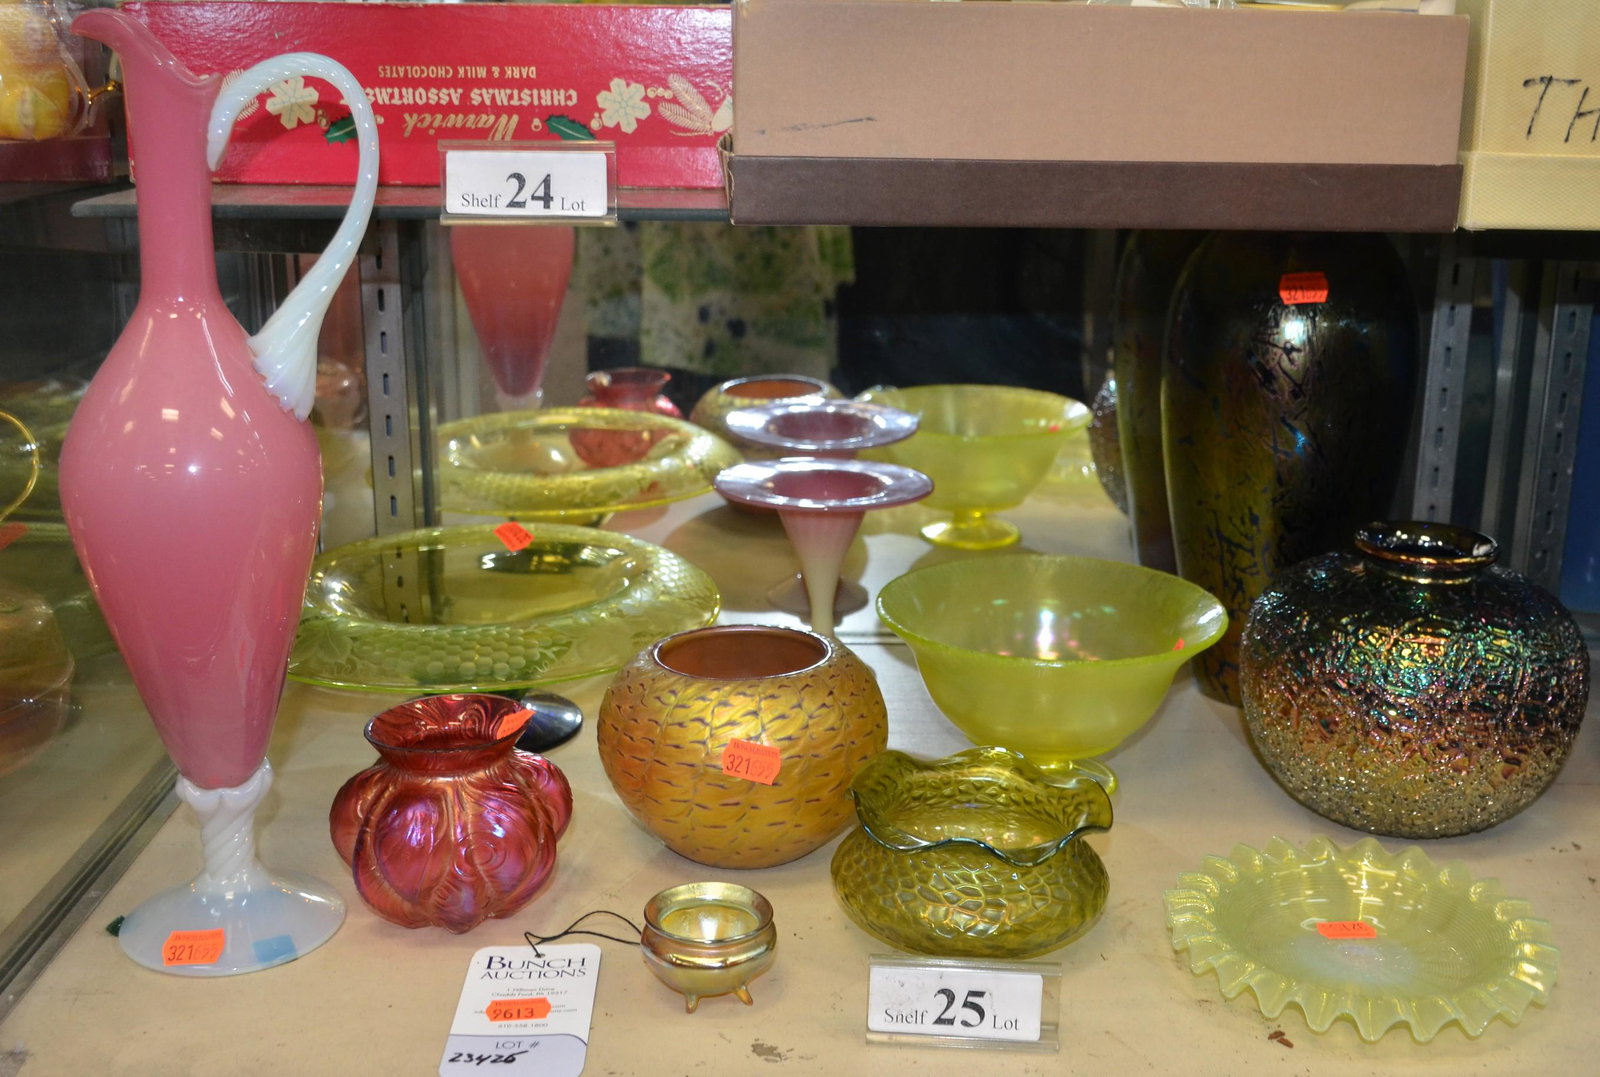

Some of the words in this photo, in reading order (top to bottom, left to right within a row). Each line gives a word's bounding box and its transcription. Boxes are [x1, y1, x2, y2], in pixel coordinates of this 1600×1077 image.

[377, 65, 454, 79] CHOCOLATES
[457, 65, 487, 79] MILK
[491, 65, 501, 79] &
[504, 66, 537, 79] DARK
[470, 87, 578, 106] CHRISTMAS
[402, 112, 520, 141] Warwick
[461, 193, 502, 209] Shelf
[505, 172, 554, 210] 24
[561, 197, 586, 212] Lot
[486, 955, 587, 970] BUNCH
[480, 968, 587, 980] AUCTIONS
[932, 988, 987, 1028] 25
[992, 1014, 1020, 1031] Lot
[495, 1040, 525, 1049] LOT
[529, 1040, 541, 1048] #
